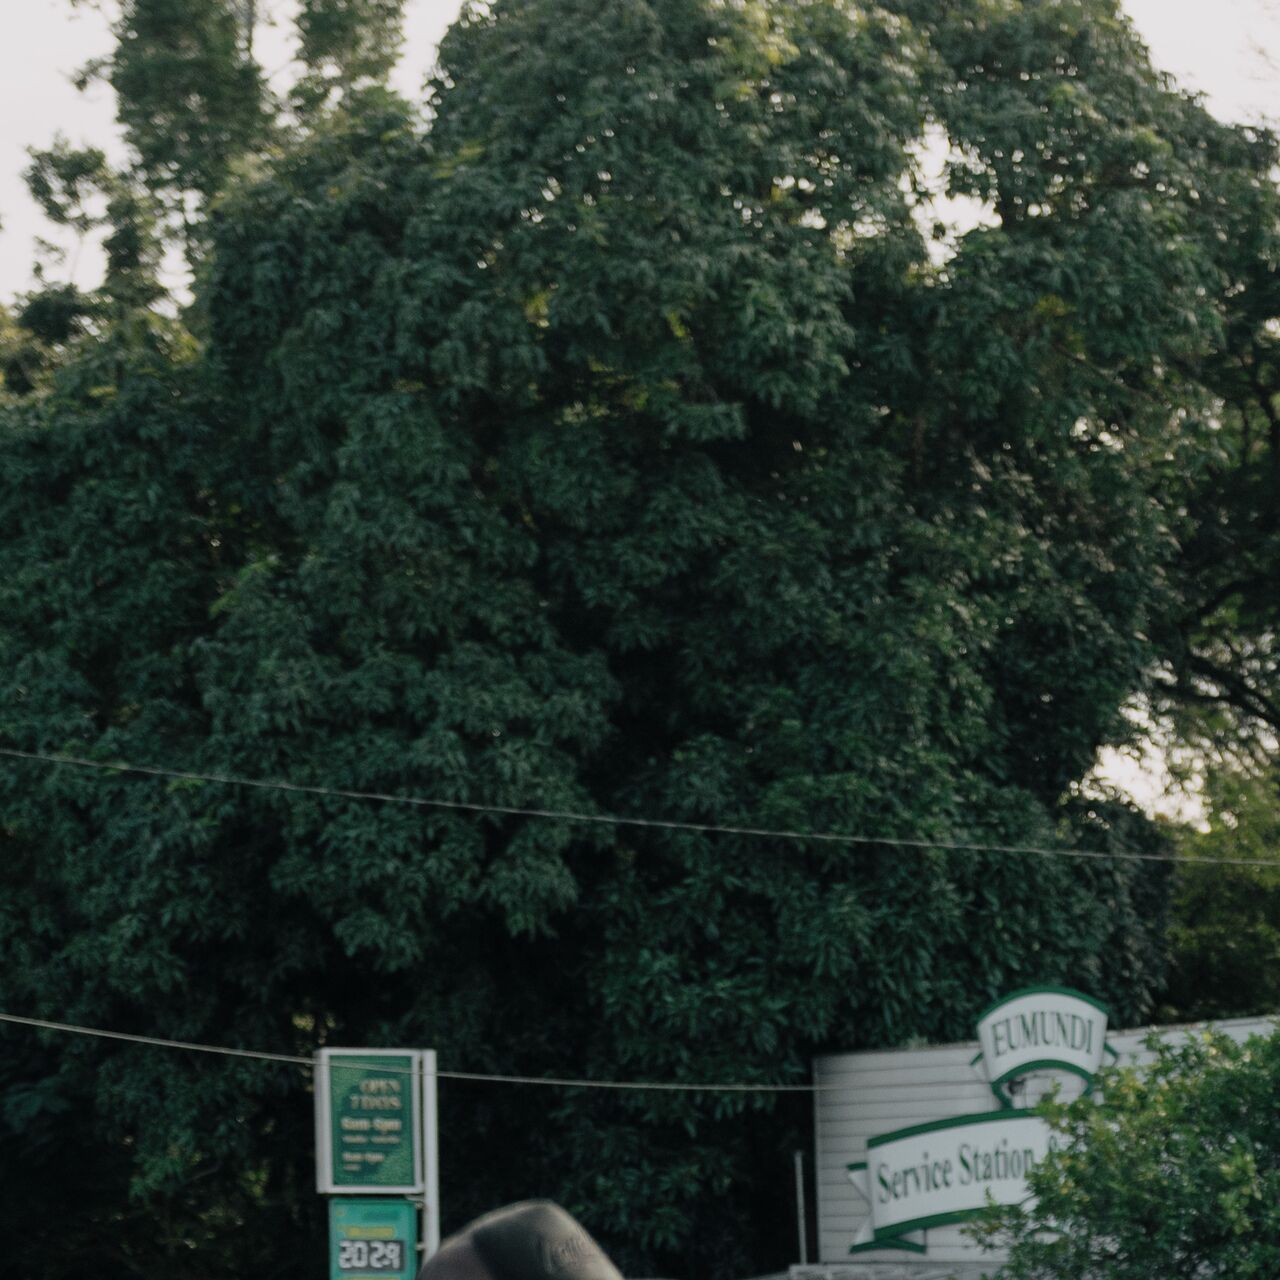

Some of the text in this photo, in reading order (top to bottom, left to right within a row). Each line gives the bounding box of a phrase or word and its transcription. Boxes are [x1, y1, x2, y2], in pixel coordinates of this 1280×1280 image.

[991, 1011, 1094, 1057] EUMUNDI
[876, 1137, 1034, 1205] Service Station
